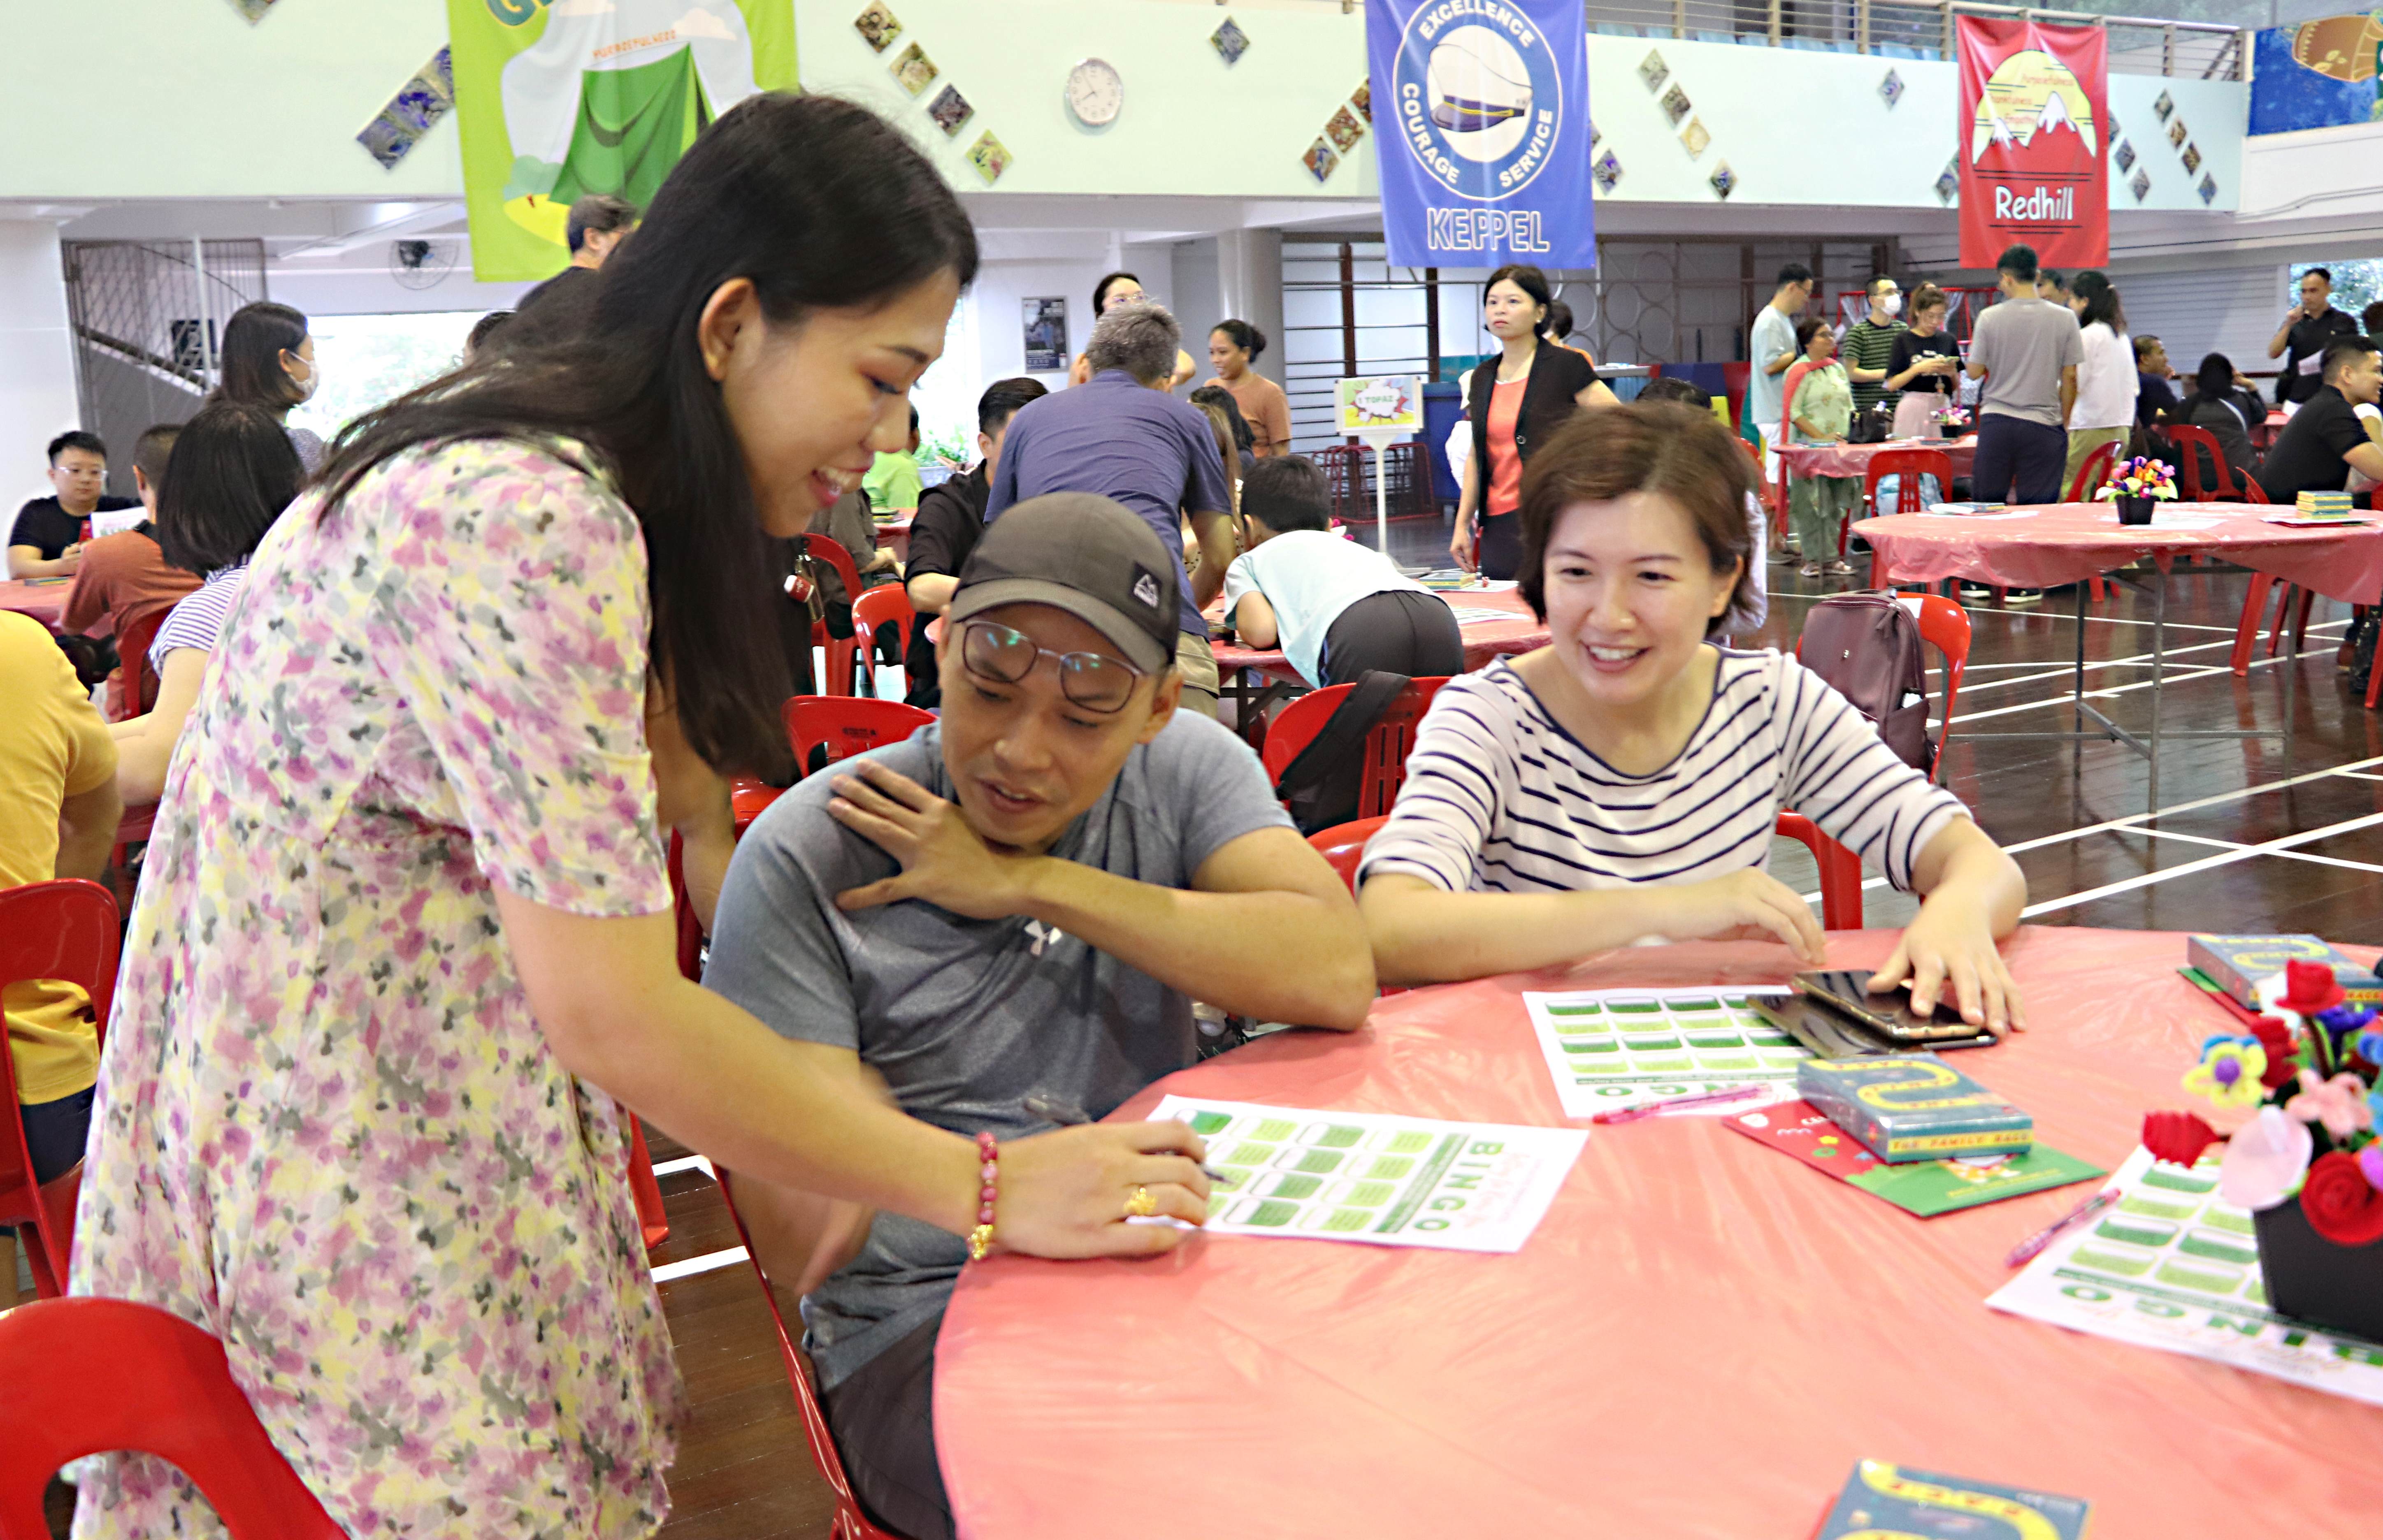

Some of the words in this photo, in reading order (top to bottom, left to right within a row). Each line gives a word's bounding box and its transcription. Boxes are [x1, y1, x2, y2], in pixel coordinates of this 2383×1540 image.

[1418, 0, 1535, 48] EXCELLENCE
[1403, 83, 1460, 184] COURAGE
[1499, 109, 1553, 188] SERVICE
[1995, 185, 2074, 220] Redhill
[1426, 207, 1551, 252] KEPPEL
[1893, 1140, 1919, 1150] THE
[1930, 1135, 1985, 1148] FAMILY
[1413, 1141, 1505, 1231] BINGO
